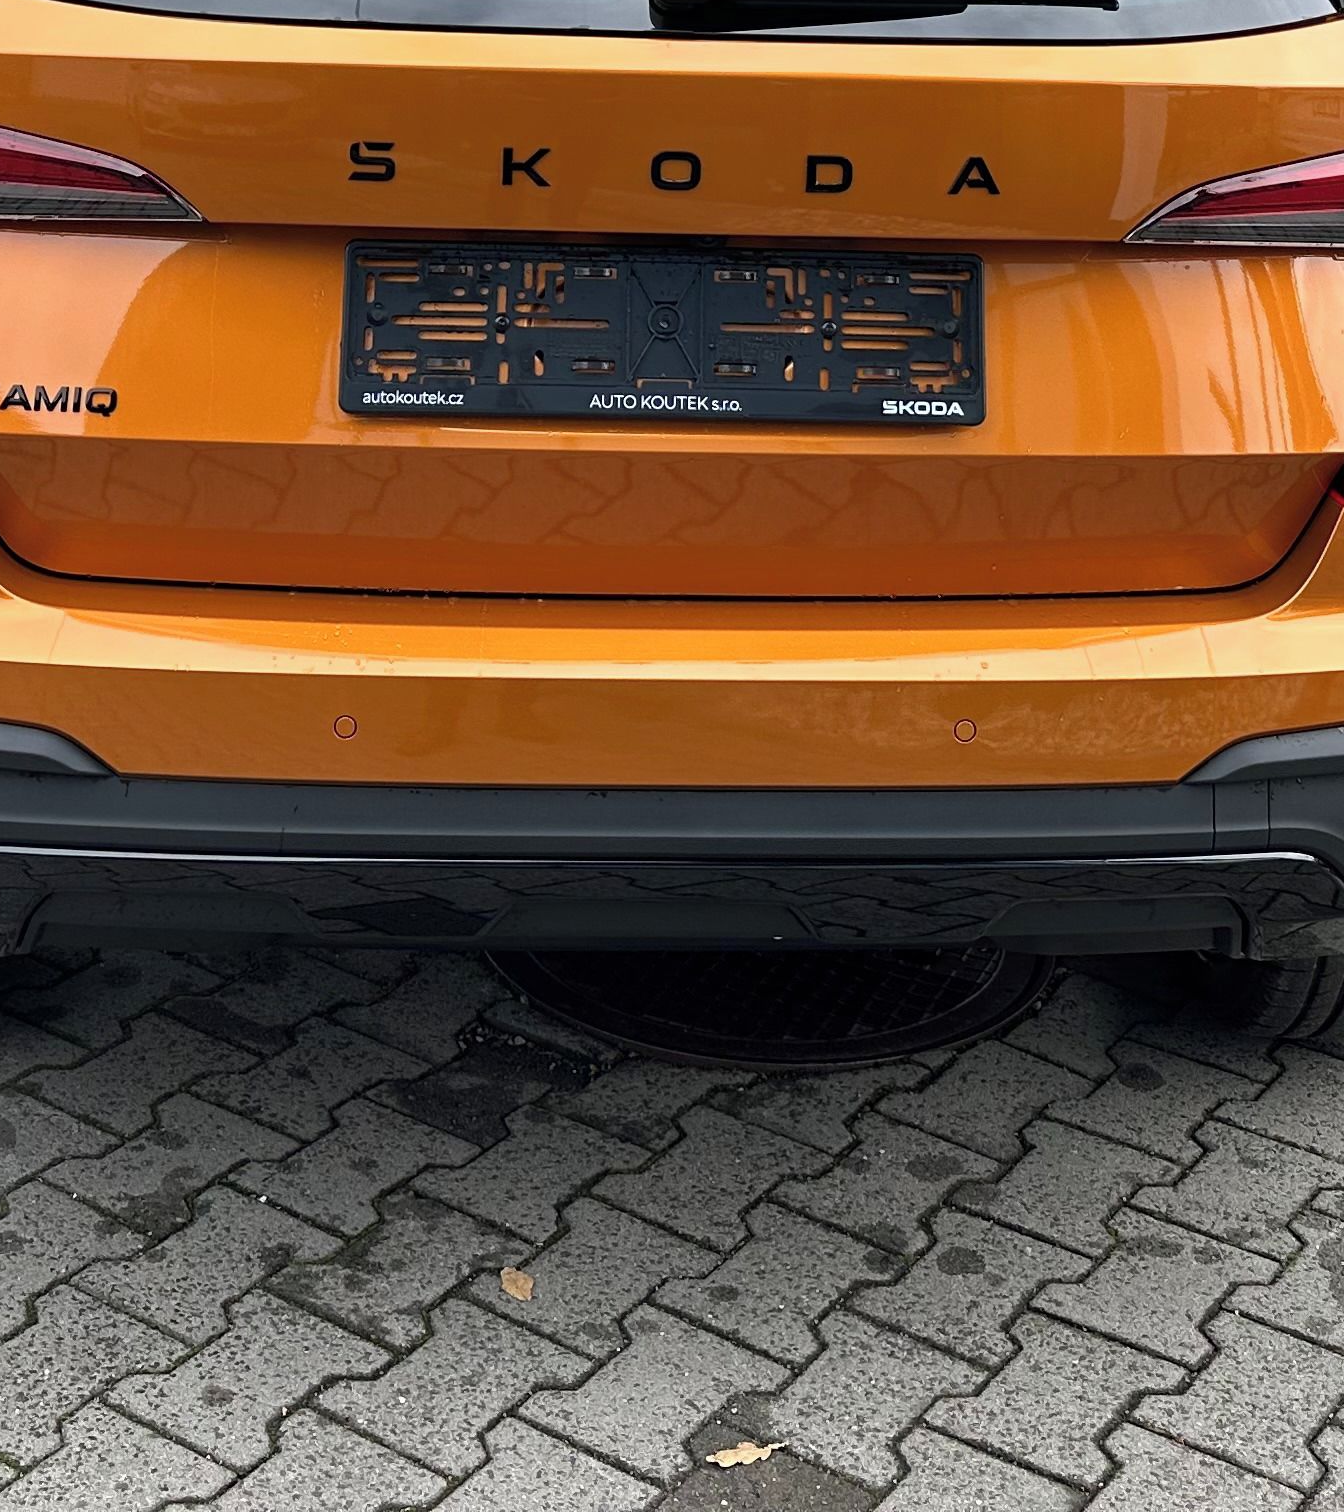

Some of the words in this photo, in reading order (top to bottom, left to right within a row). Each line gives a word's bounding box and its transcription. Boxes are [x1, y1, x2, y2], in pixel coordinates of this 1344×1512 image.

[362, 390, 465, 405] autokoutek.cz
[589, 394, 637, 409] AUTO
[640, 395, 709, 411] KOUTEK
[711, 399, 743, 412] s.r.o.
